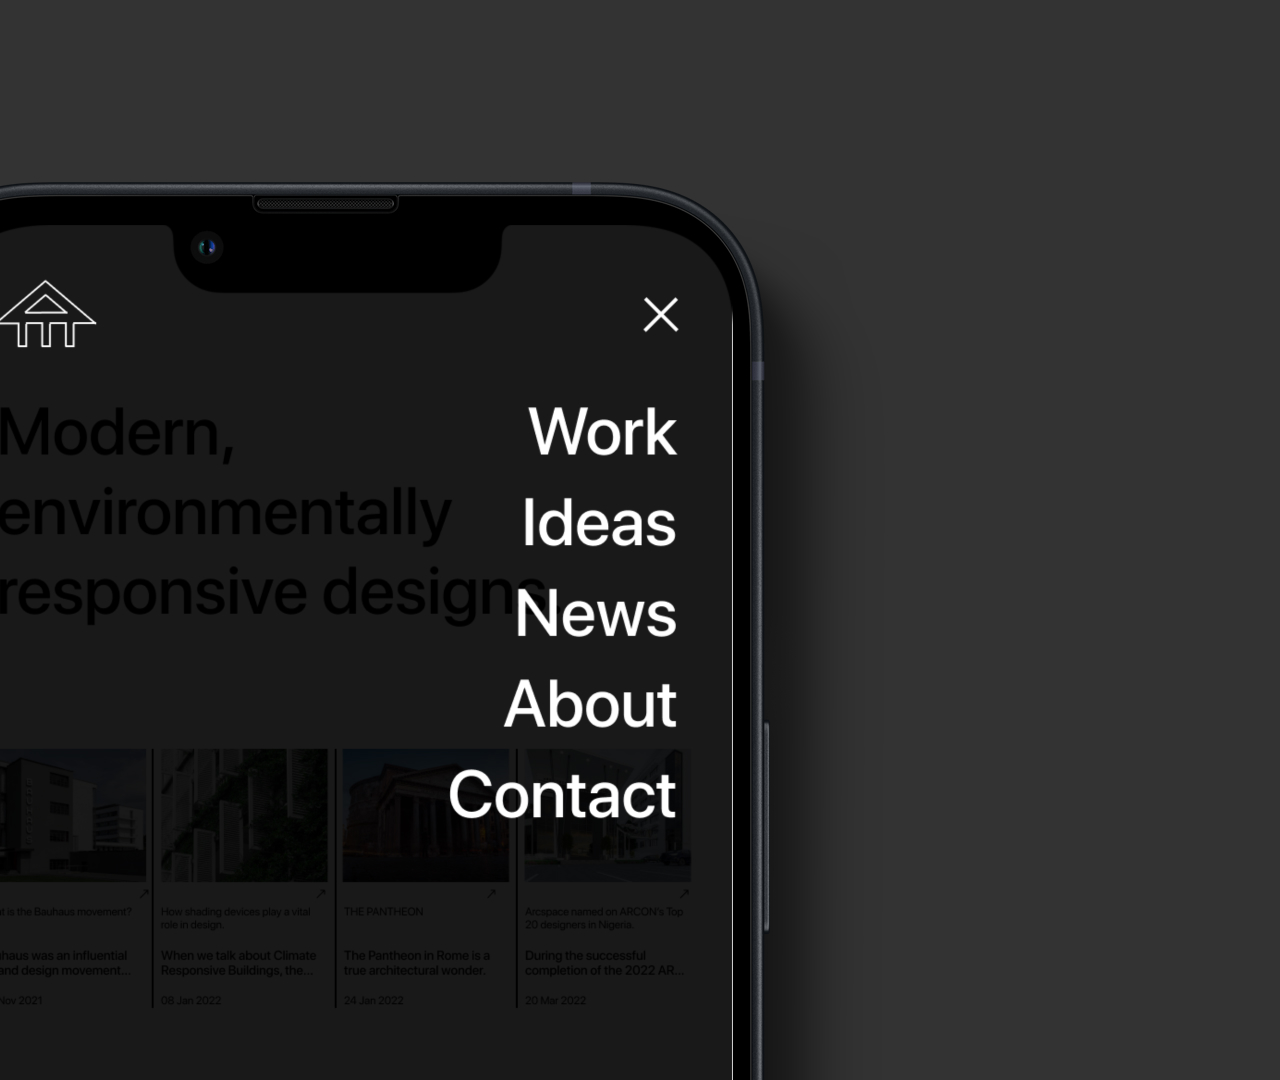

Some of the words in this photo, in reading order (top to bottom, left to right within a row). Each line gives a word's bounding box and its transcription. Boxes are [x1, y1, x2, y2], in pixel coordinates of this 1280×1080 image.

[0, 406, 234, 466] Modern,
[528, 406, 678, 456] Work
[524, 497, 676, 547] Ideas
[0, 566, 307, 626] responsive
[517, 588, 677, 638] News
[503, 678, 677, 729] About
[449, 768, 676, 819] Contact
[6, 907, 15, 917] is
[16, 907, 33, 917] the
[33, 906, 76, 917] Bauhaus
[77, 906, 133, 917] movement?
[161, 906, 183, 917] How
[184, 906, 223, 919] shading
[223, 907, 261, 917] devices
[262, 906, 282, 919] play
[283, 909, 290, 917] a
[291, 906, 311, 917] vital
[343, 906, 365, 917] THE
[366, 906, 424, 917] PANTHEON
[524, 906, 570, 918] Arcspace
[570, 906, 604, 917] named
[605, 909, 618, 917] on
[666, 906, 684, 918] Top
[160, 920, 179, 930] role
[179, 920, 189, 929] in
[190, 919, 225, 932] design.
[525, 919, 539, 930] 20
[540, 920, 587, 932] designers
[588, 920, 597, 929] in
[598, 919, 635, 932] Nigeria.
[31, 952, 55, 961] was
[56, 952, 71, 961] an
[72, 949, 128, 961] influential
[160, 950, 195, 961] When
[196, 952, 214, 961] we
[215, 950, 237, 961] talk
[238, 949, 272, 961] about
[273, 949, 317, 961] Climate
[343, 949, 366, 961] The
[368, 949, 422, 961] Pantheon
[423, 950, 435, 961] in
[436, 949, 470, 961] Rome
[471, 950, 481, 961] is
[482, 952, 491, 961] a
[525, 949, 563, 964] During
[564, 950, 584, 961] the
[585, 949, 646, 961] successful
[20, 964, 60, 978] design
[161, 964, 226, 978] Responsive
[228, 964, 283, 979] Buildings,
[343, 965, 367, 976] true
[368, 964, 439, 976] architectural
[440, 964, 486, 976] wonder.
[524, 964, 588, 978] completion
[589, 964, 602, 976] of
[603, 964, 623, 976] the
[624, 964, 656, 976] 2022
[18, 995, 43, 1005] 2021
[160, 995, 175, 1005] 08
[176, 995, 194, 1006] Jan
[195, 995, 222, 1005] 2022
[344, 995, 357, 1005] 24
[358, 995, 377, 1006] Jan
[378, 995, 404, 1006] 2022
[525, 995, 539, 1005] 20
[540, 995, 559, 1005] Mar
[560, 995, 587, 1006] 2022
